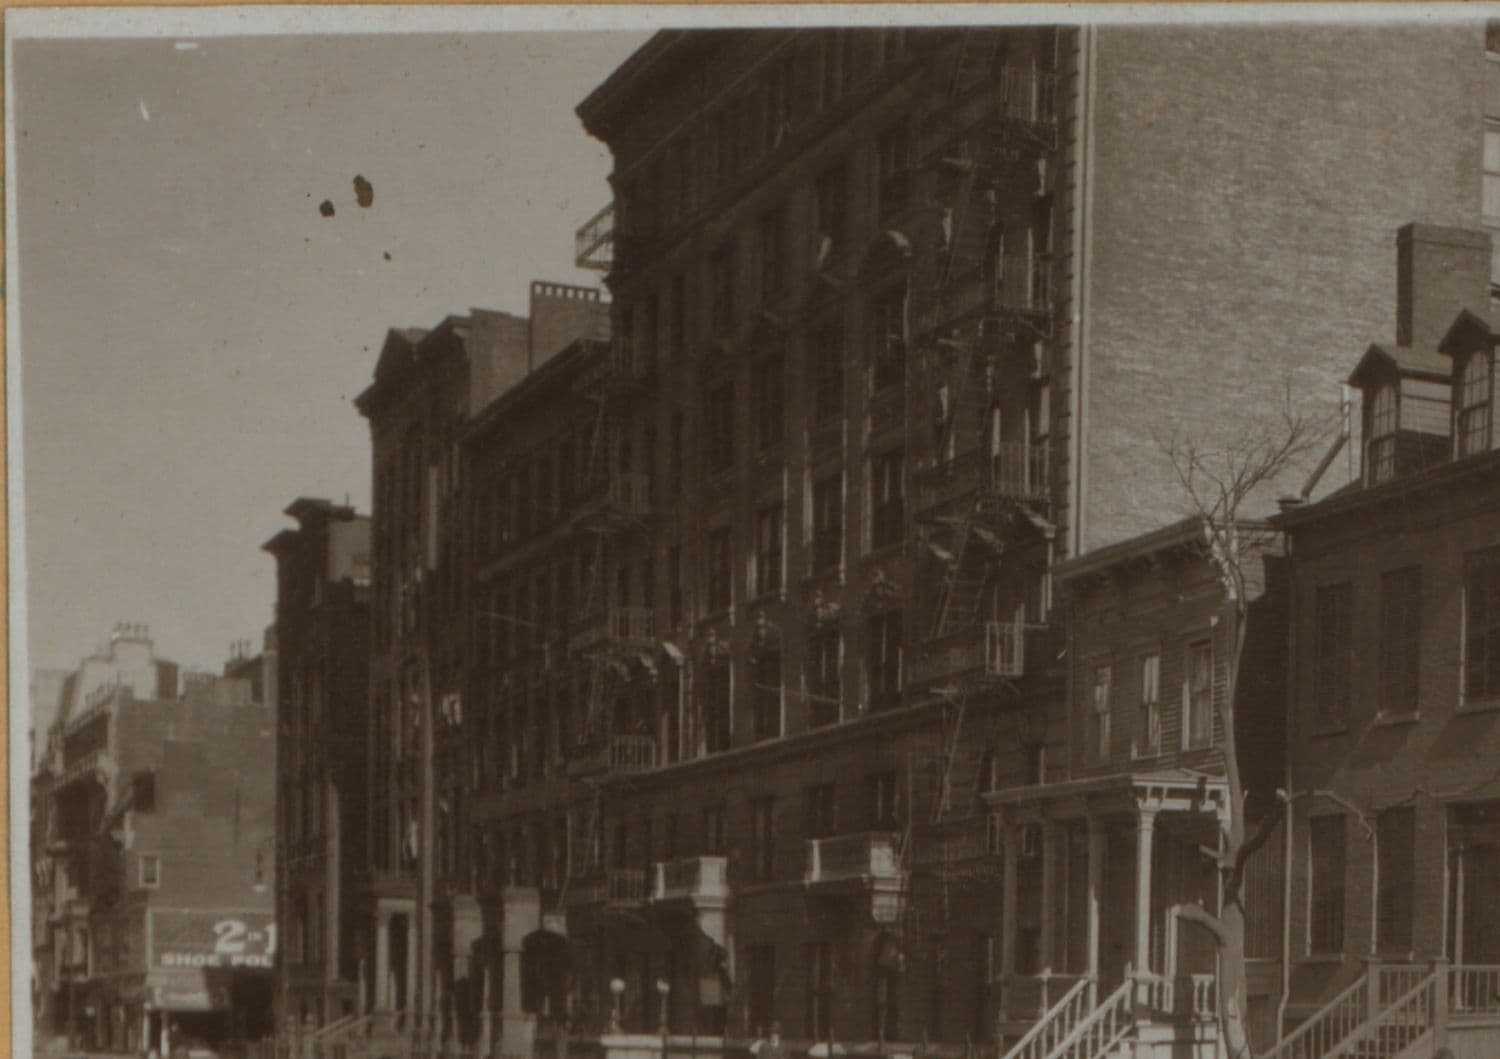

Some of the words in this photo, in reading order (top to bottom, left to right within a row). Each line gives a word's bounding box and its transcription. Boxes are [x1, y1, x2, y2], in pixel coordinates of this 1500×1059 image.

[213, 919, 246, 953] 2
[160, 952, 221, 967] SHOE
[231, 953, 273, 968] POL
